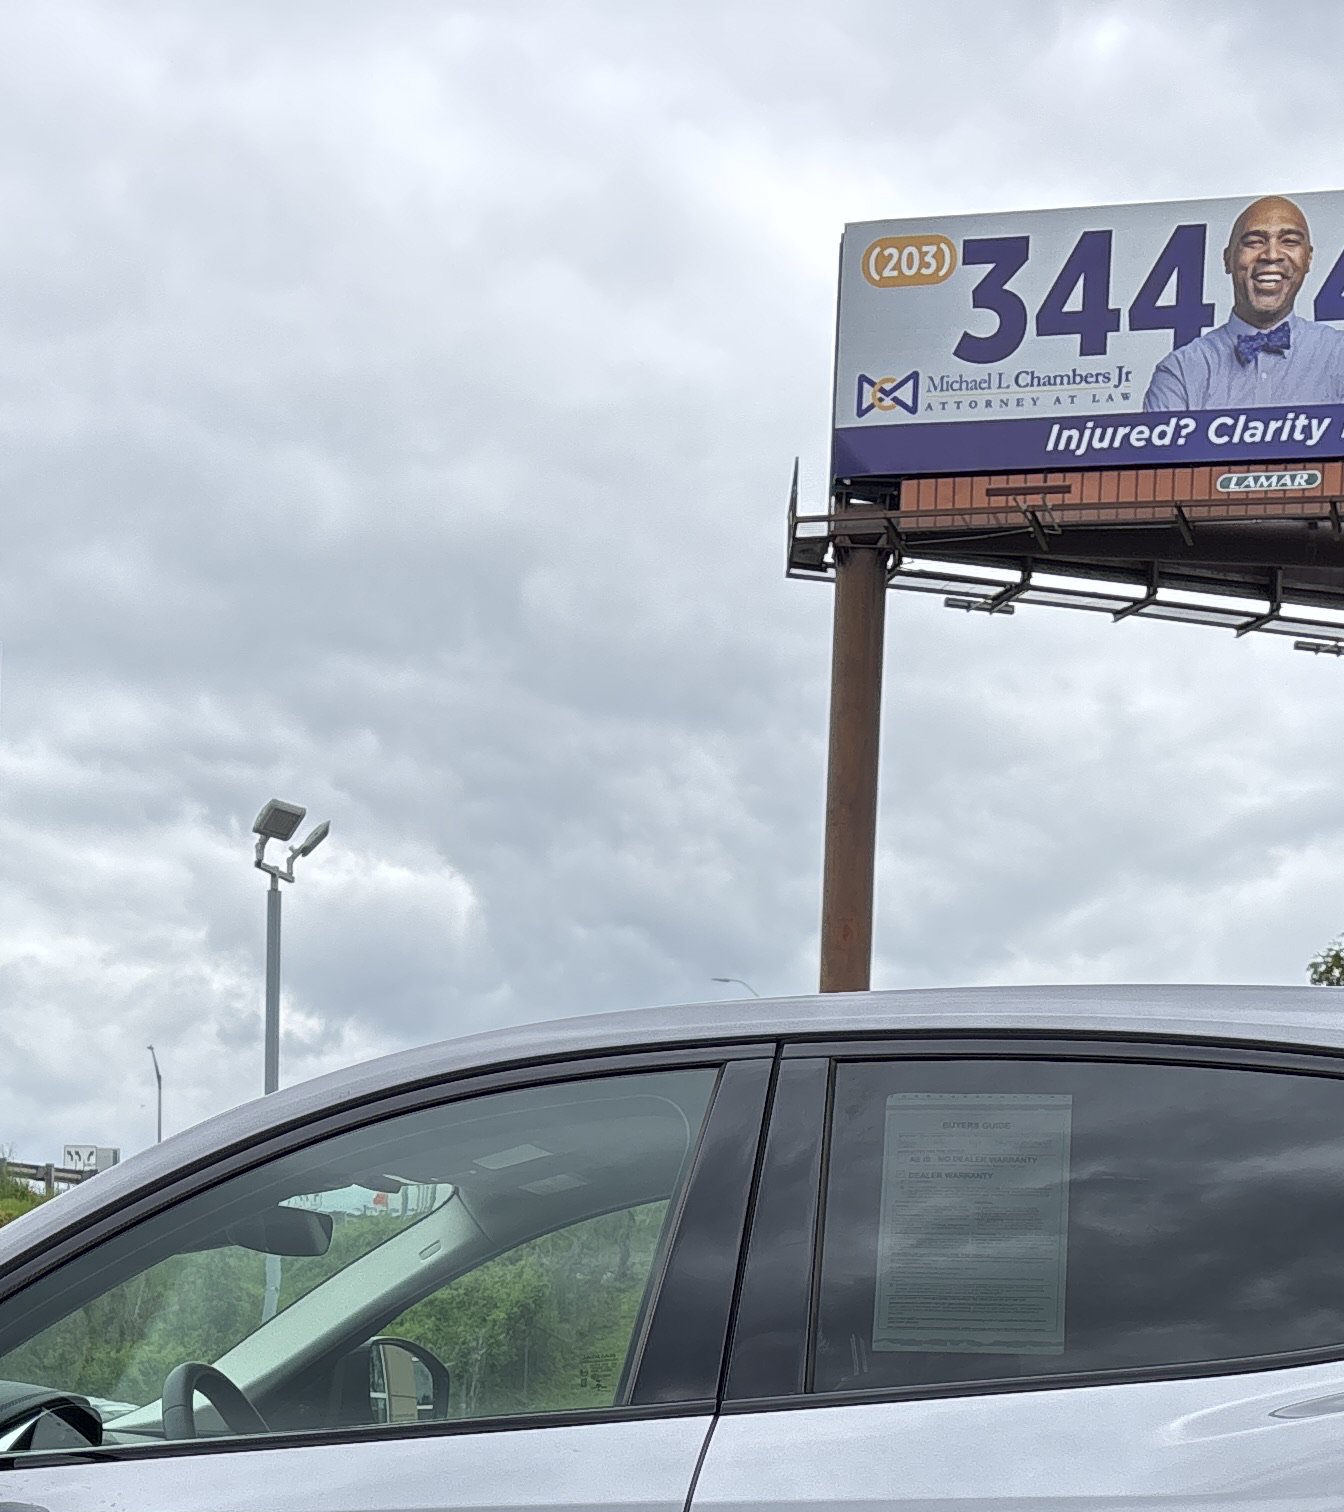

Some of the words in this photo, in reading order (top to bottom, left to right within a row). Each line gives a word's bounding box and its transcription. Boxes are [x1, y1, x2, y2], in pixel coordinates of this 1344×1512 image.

[867, 242, 952, 281] (203)
[953, 223, 1215, 364] 344
[926, 373, 992, 393] Michael
[996, 371, 1010, 390] L
[1014, 367, 1111, 388] Chambers
[1113, 365, 1133, 388] Jr
[925, 396, 1041, 412] ATTORNEY
[1053, 394, 1077, 406] AT
[1092, 391, 1133, 404] LAW
[1045, 417, 1197, 456] Injured?
[1207, 412, 1331, 446] Clarity
[1228, 472, 1309, 489] LAMAR
